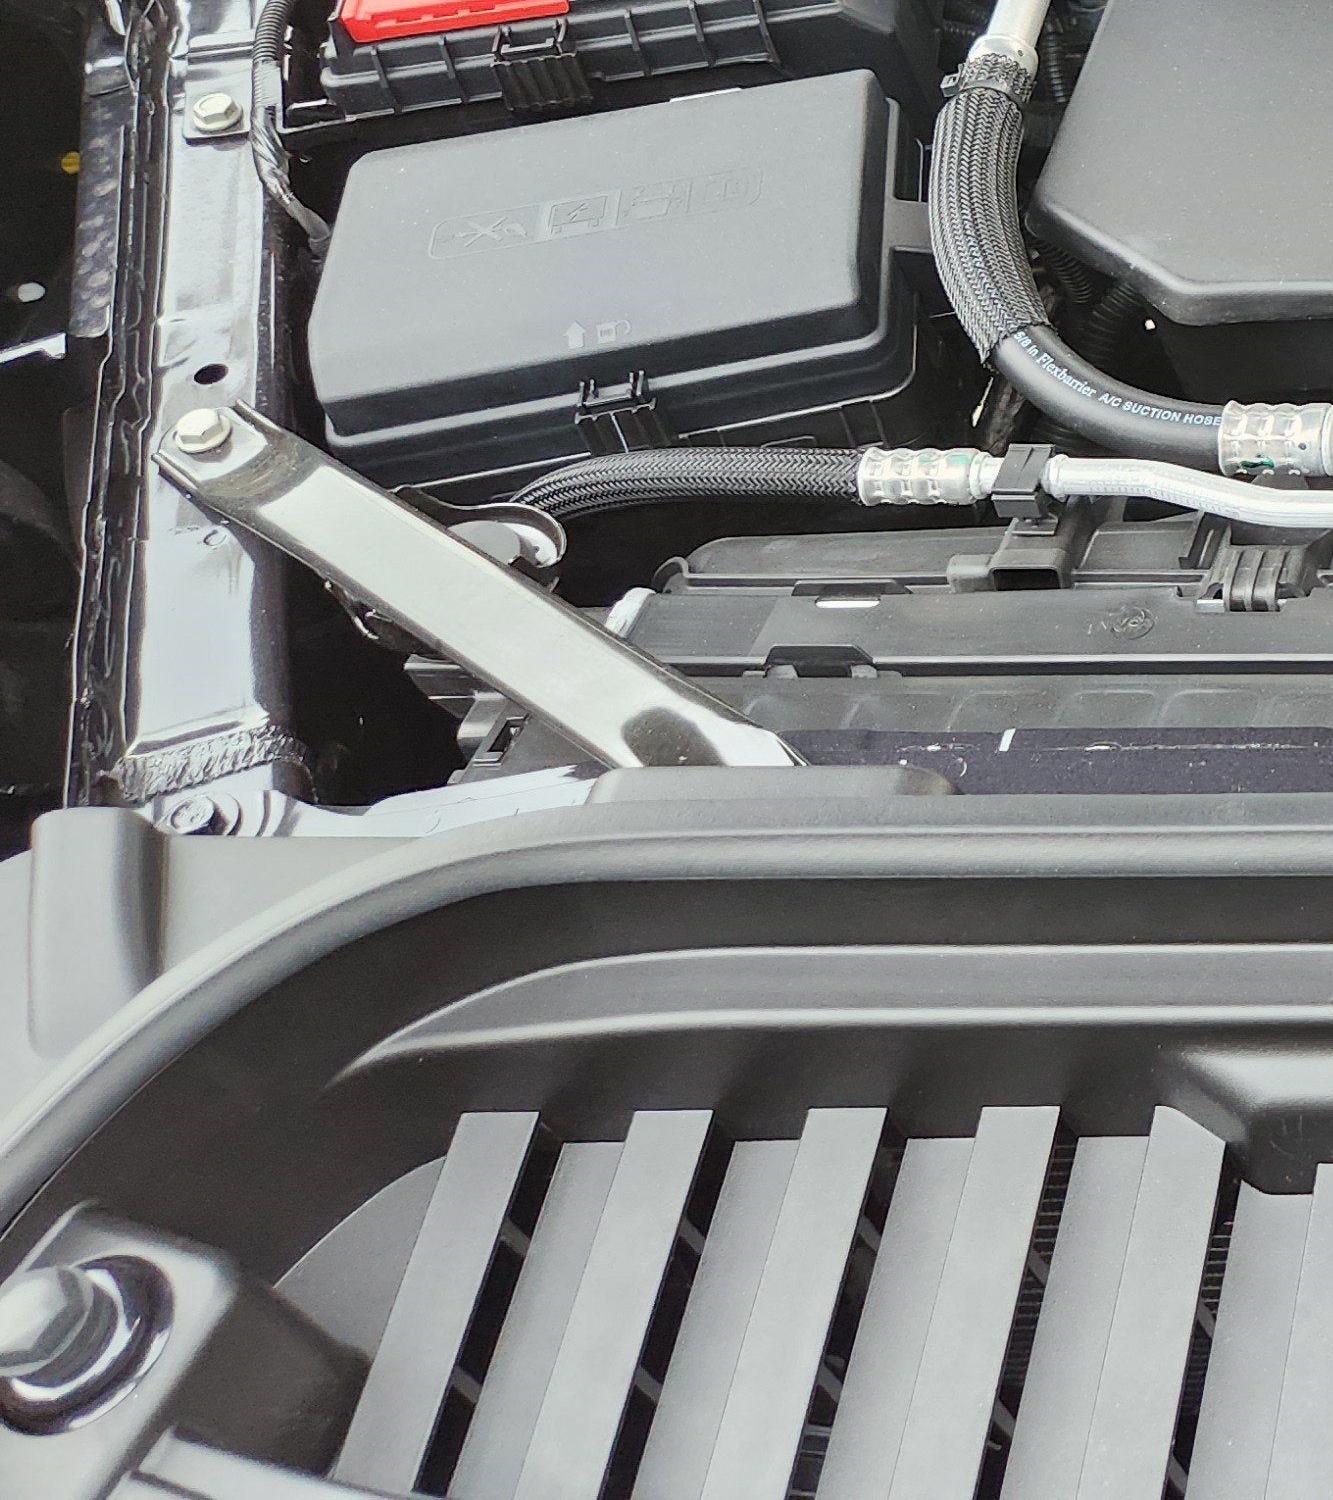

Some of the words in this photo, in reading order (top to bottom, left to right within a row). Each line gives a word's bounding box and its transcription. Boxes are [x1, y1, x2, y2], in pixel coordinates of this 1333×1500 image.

[1036, 352, 1097, 397] Flexbarrier
[1098, 392, 1123, 407] A/C
[1122, 401, 1182, 423] SUCTION
[1182, 413, 1222, 426] HOSE
